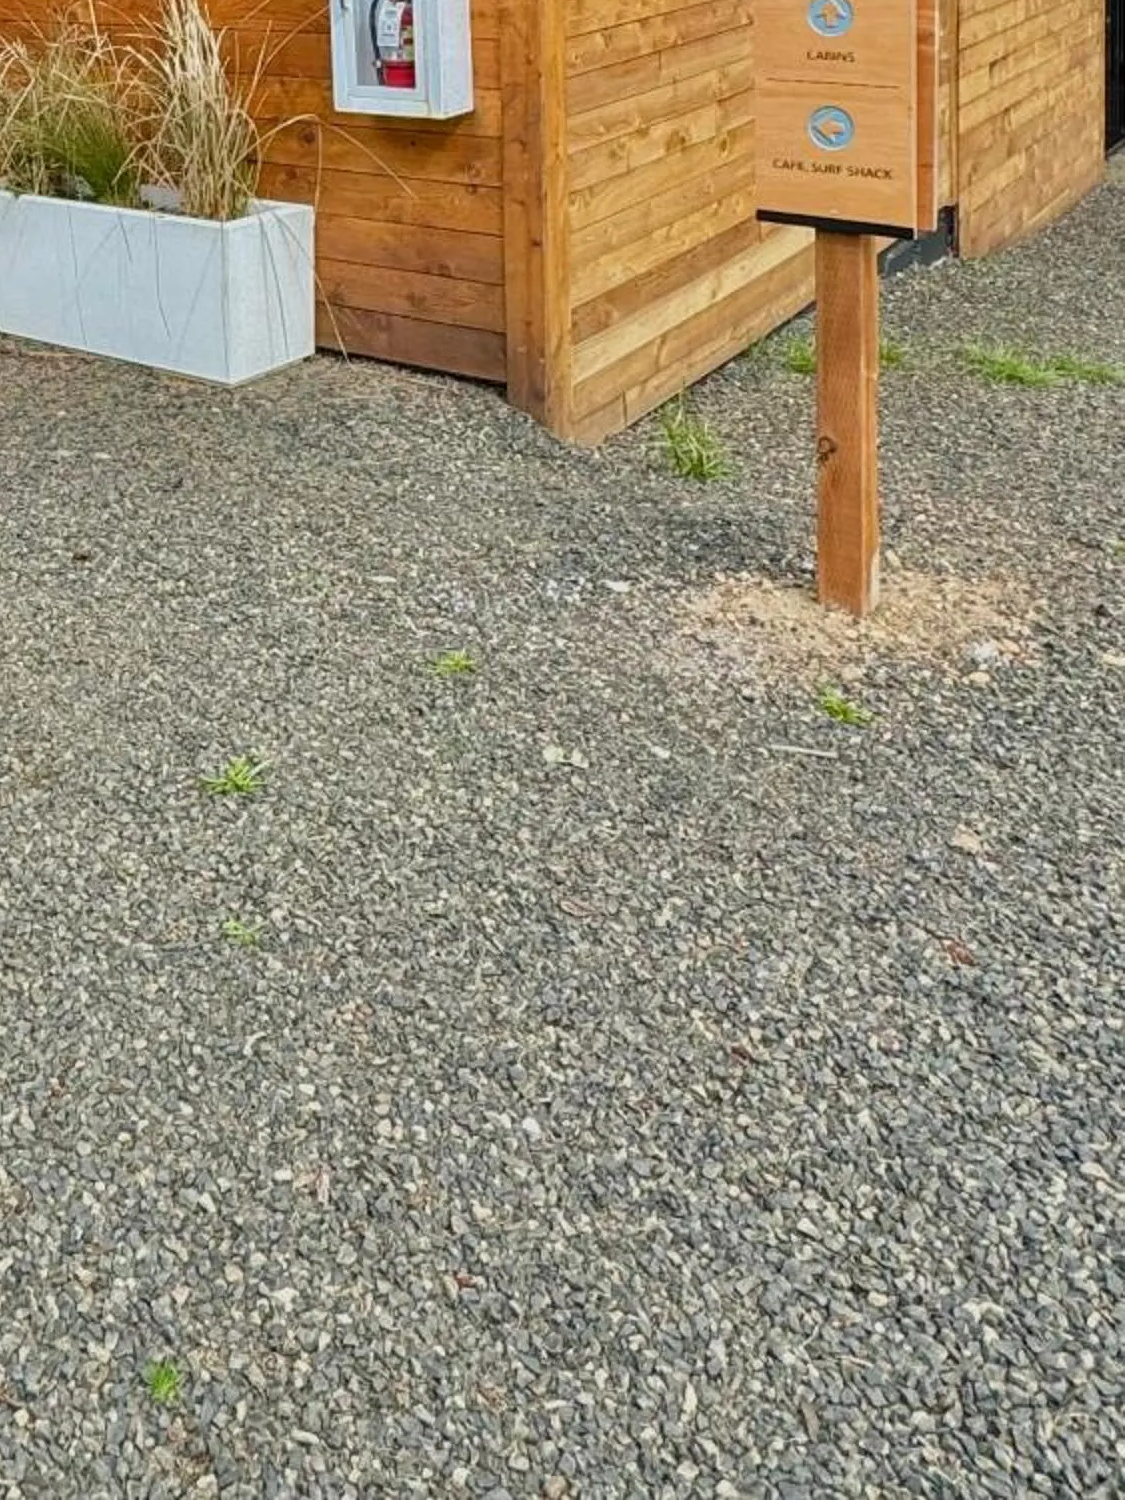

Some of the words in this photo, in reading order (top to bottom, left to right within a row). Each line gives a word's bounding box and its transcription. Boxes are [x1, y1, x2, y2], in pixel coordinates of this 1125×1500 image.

[806, 51, 855, 62] CABINS
[811, 163, 842, 174] SURF
[846, 166, 893, 180] SHACK
